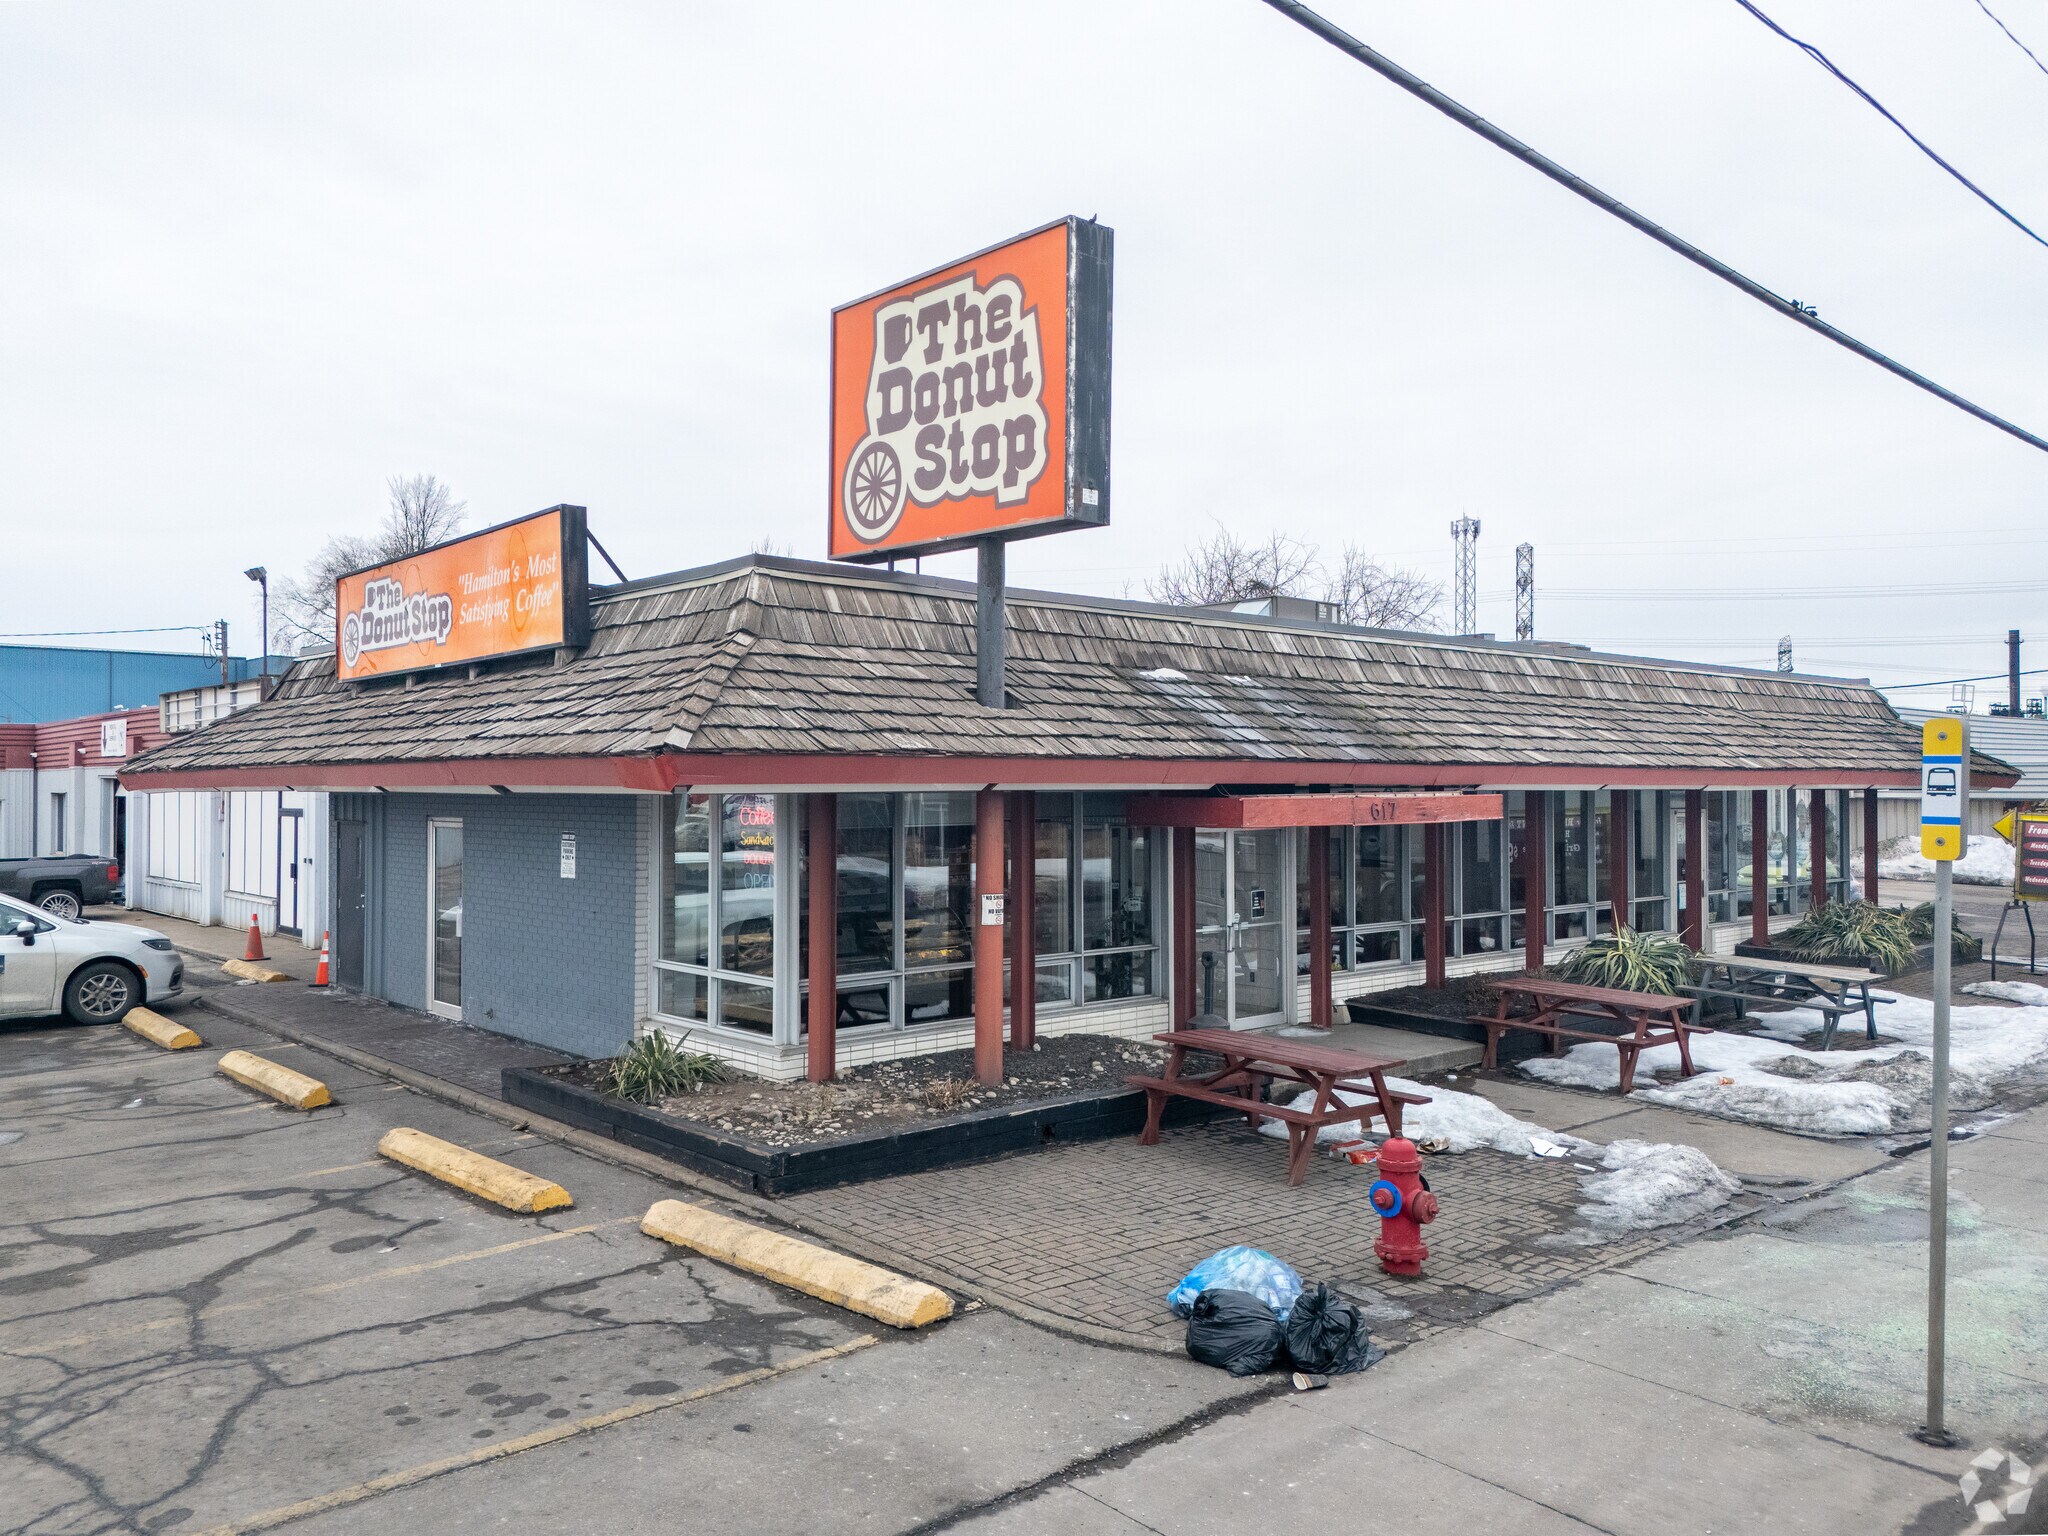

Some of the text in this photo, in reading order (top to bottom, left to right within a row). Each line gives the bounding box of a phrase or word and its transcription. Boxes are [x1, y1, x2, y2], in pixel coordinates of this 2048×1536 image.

[916, 292, 1013, 365] The
[876, 328, 1034, 436] Donut
[913, 413, 1037, 491] Stop
[458, 551, 557, 595] "Hamilton's Most
[377, 583, 401, 611] The
[459, 581, 559, 627] Satisfying Coffee"
[361, 598, 450, 646] Donut Stop
[1370, 802, 1396, 821] 617
